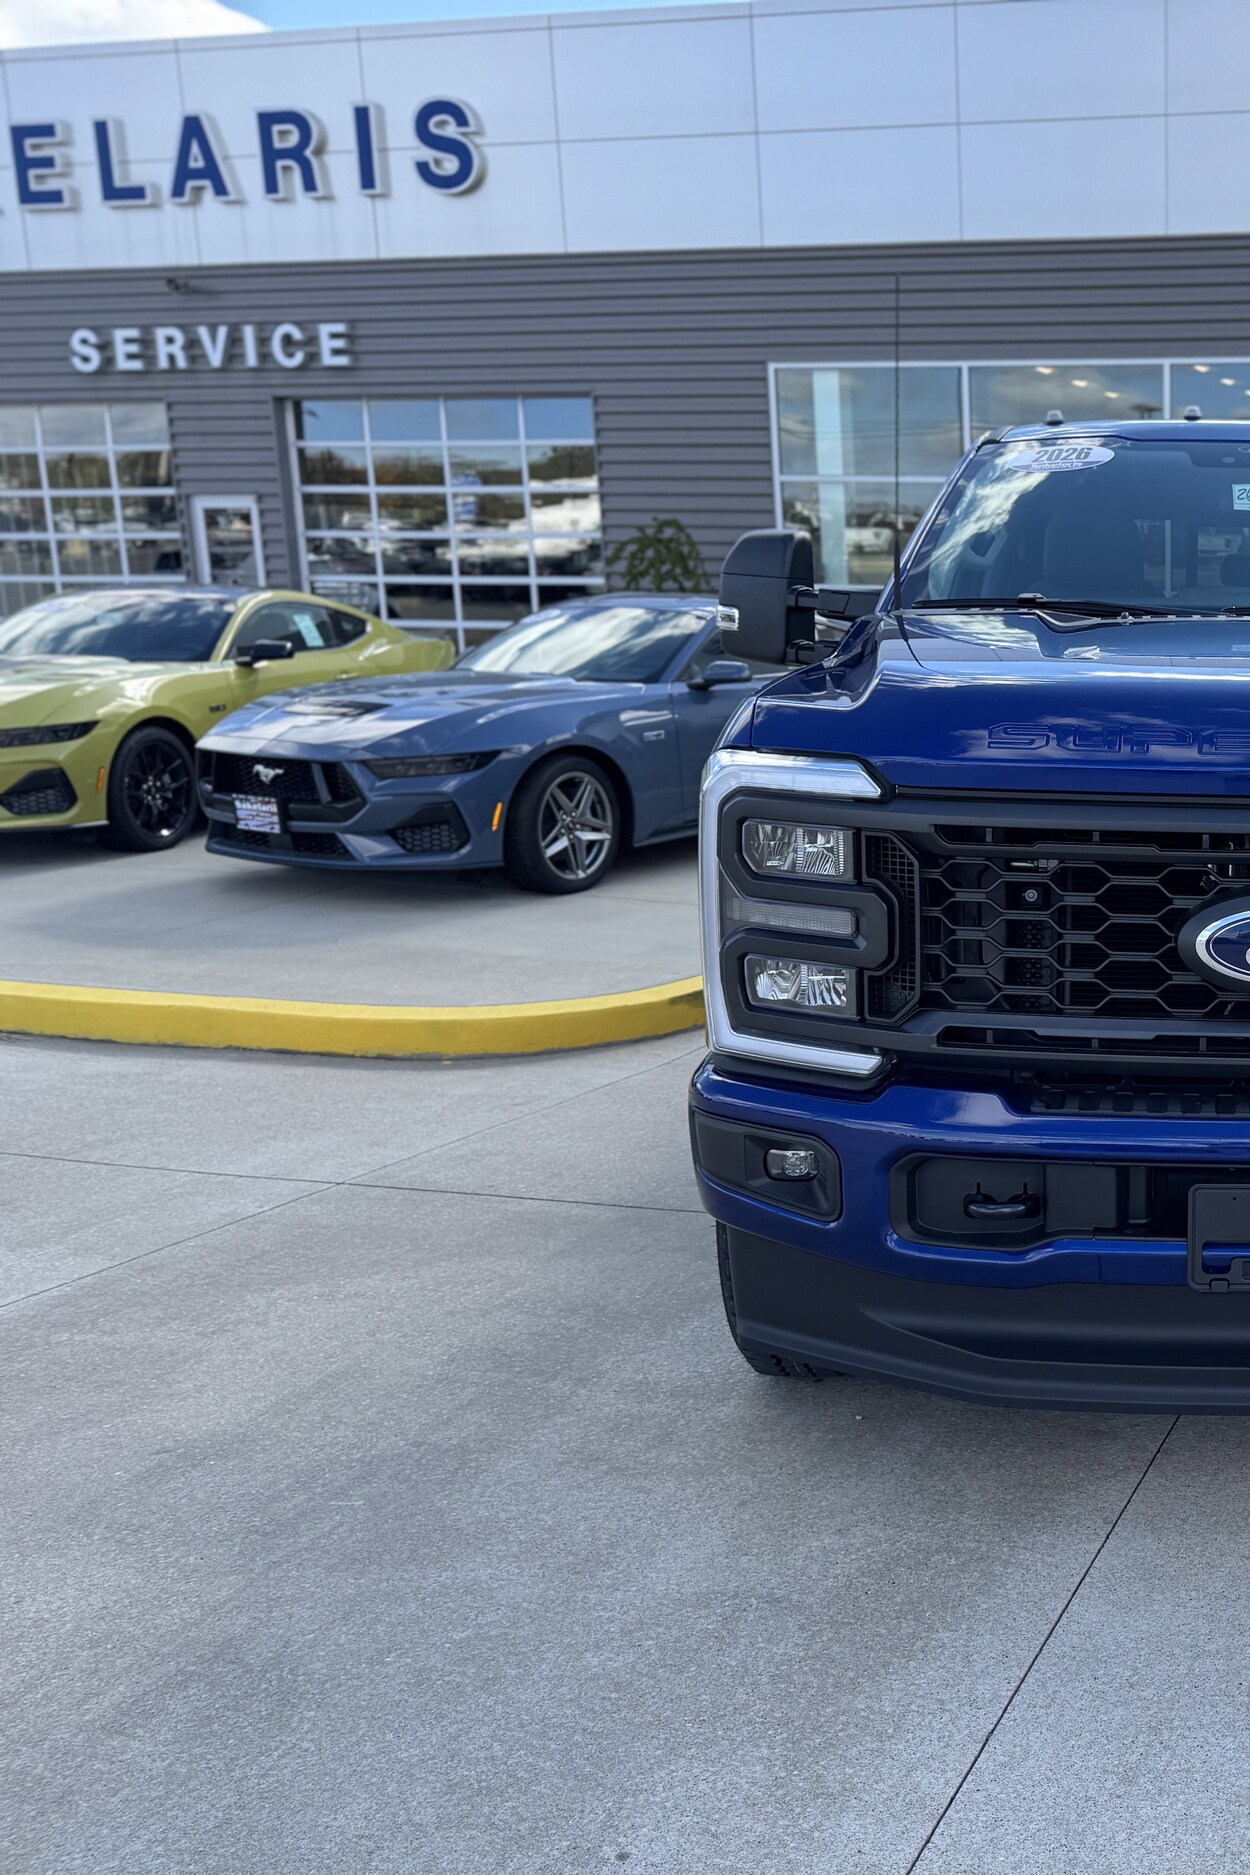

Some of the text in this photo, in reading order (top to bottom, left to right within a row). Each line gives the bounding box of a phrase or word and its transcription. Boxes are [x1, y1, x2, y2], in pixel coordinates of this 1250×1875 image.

[0, 97, 482, 212] ELARIS
[69, 322, 351, 374] SERVICE
[1032, 447, 1093, 463] 2026
